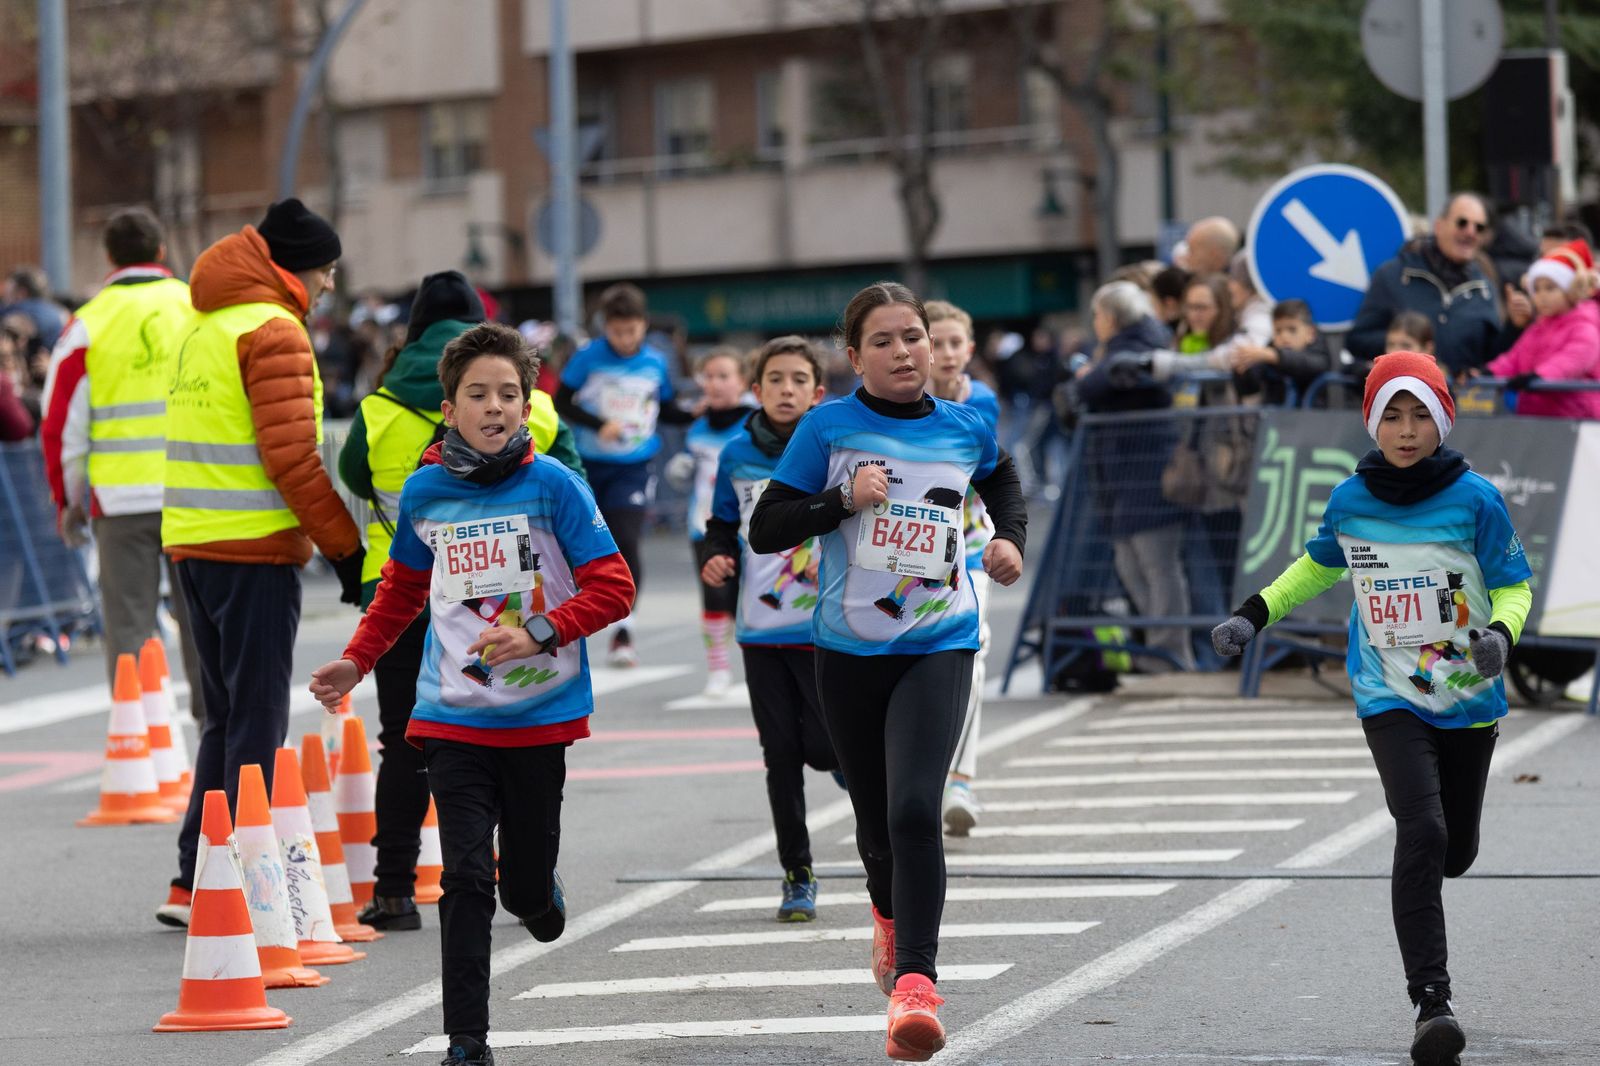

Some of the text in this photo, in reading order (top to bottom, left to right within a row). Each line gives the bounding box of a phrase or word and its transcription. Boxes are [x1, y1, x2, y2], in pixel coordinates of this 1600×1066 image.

[889, 503, 950, 524] SETEL
[456, 521, 519, 540] SETEL
[871, 517, 936, 554] 6423
[446, 538, 507, 576] 6394
[898, 562, 926, 571] Ayuntamiento
[903, 568, 926, 576] Salamanca
[1374, 576, 1438, 592] SETEL
[1368, 592, 1423, 625] 6471
[1396, 633, 1424, 641] Ayuntamiento
